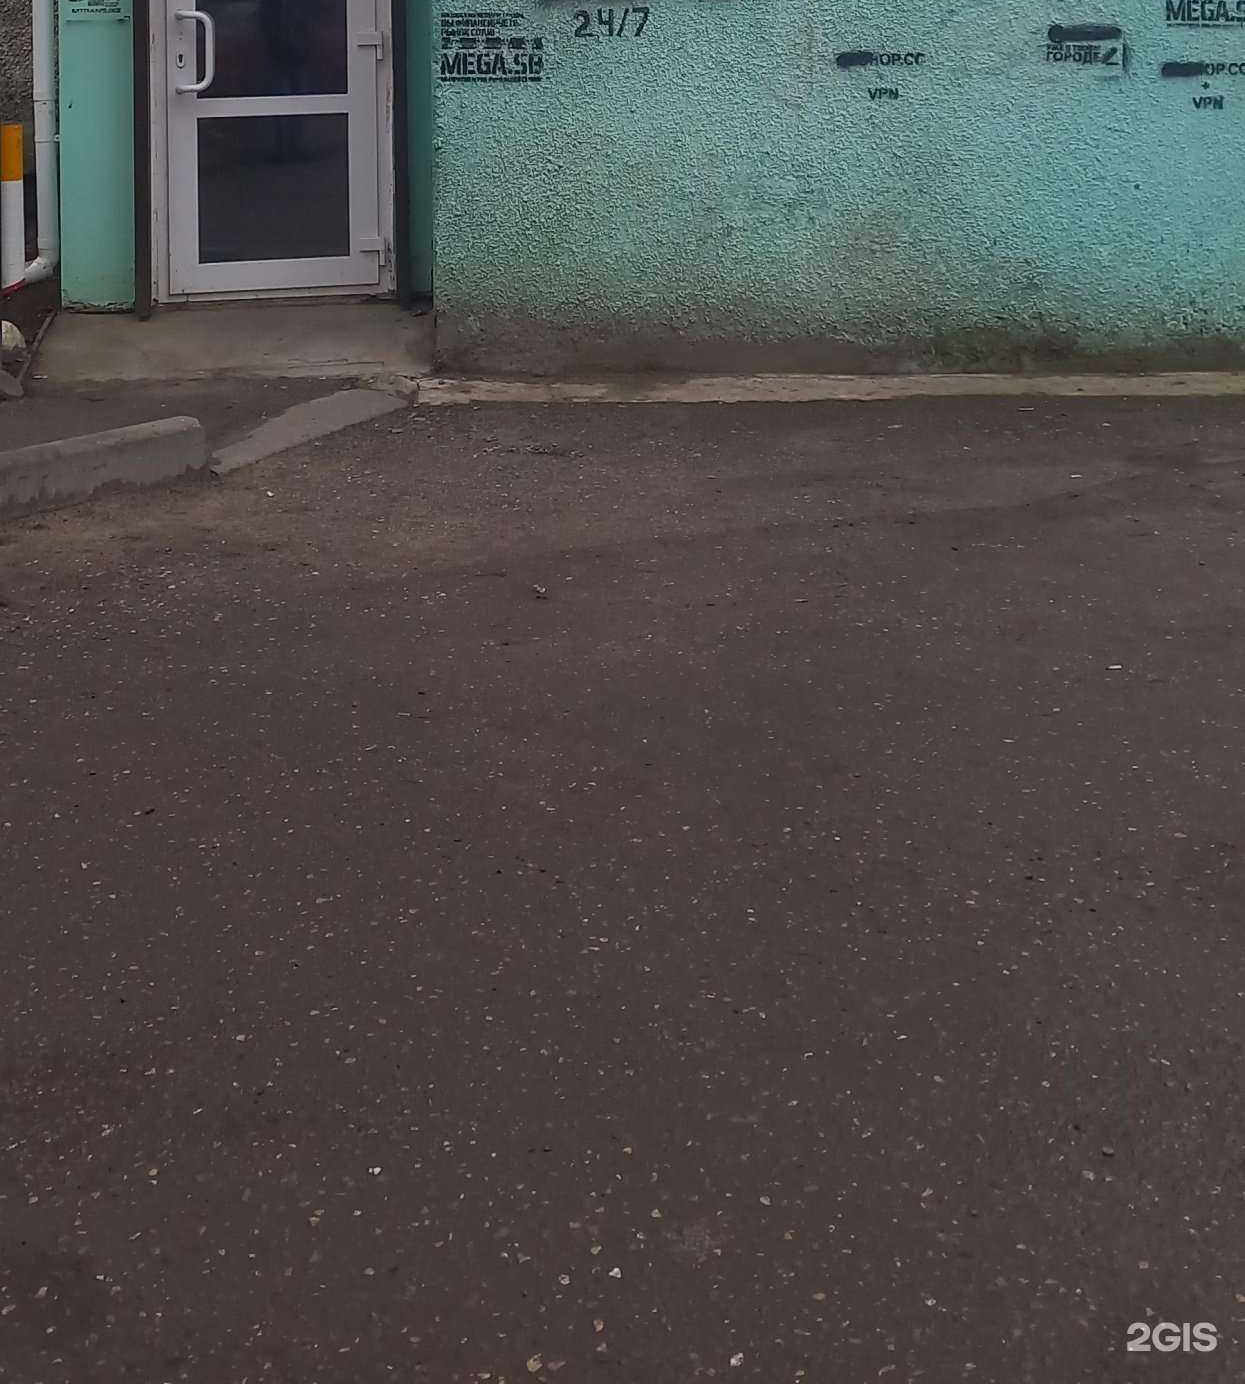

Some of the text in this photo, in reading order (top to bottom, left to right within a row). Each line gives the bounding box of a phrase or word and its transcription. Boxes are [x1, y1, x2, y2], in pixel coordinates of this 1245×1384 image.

[574, 6, 650, 38] 24/7
[867, 87, 899, 101] VPN
[1192, 95, 1224, 110] VPN
